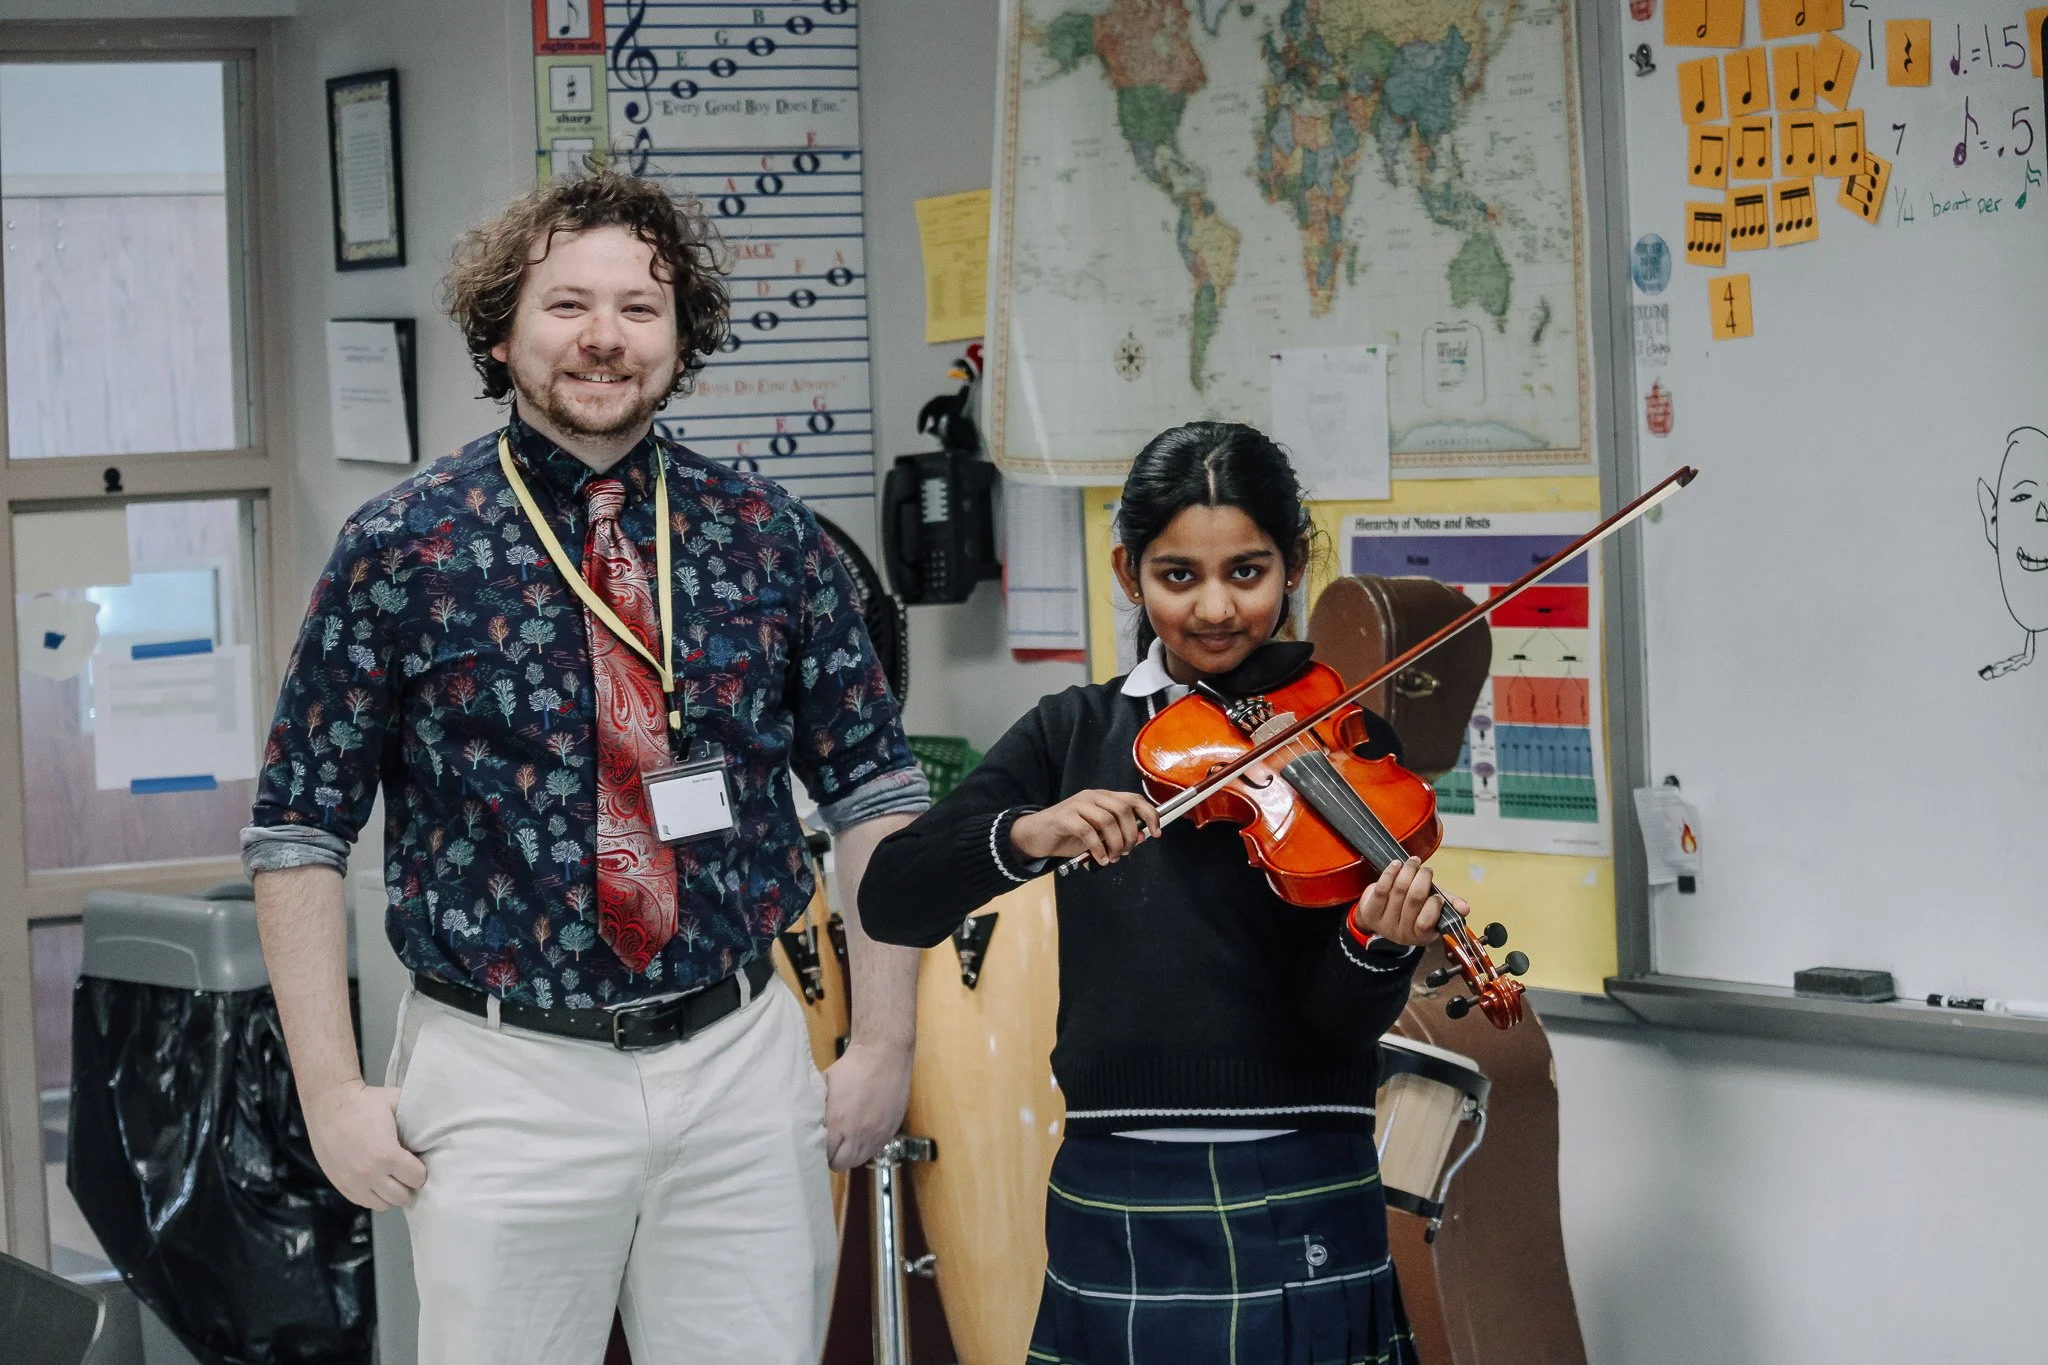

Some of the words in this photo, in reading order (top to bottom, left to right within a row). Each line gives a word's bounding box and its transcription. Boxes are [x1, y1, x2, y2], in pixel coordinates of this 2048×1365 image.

[714, 30, 729, 46] G
[675, 51, 688, 67] E
[704, 99, 741, 116] Good
[556, 114, 592, 125] sharp
[760, 156, 775, 172] C
[723, 177, 738, 193] A
[1355, 517, 1399, 533] Hierarchy
[1402, 517, 1412, 530] of
[1414, 517, 1441, 530] Notes
[1445, 516, 1462, 529] and
[1465, 516, 1491, 529] Rests
